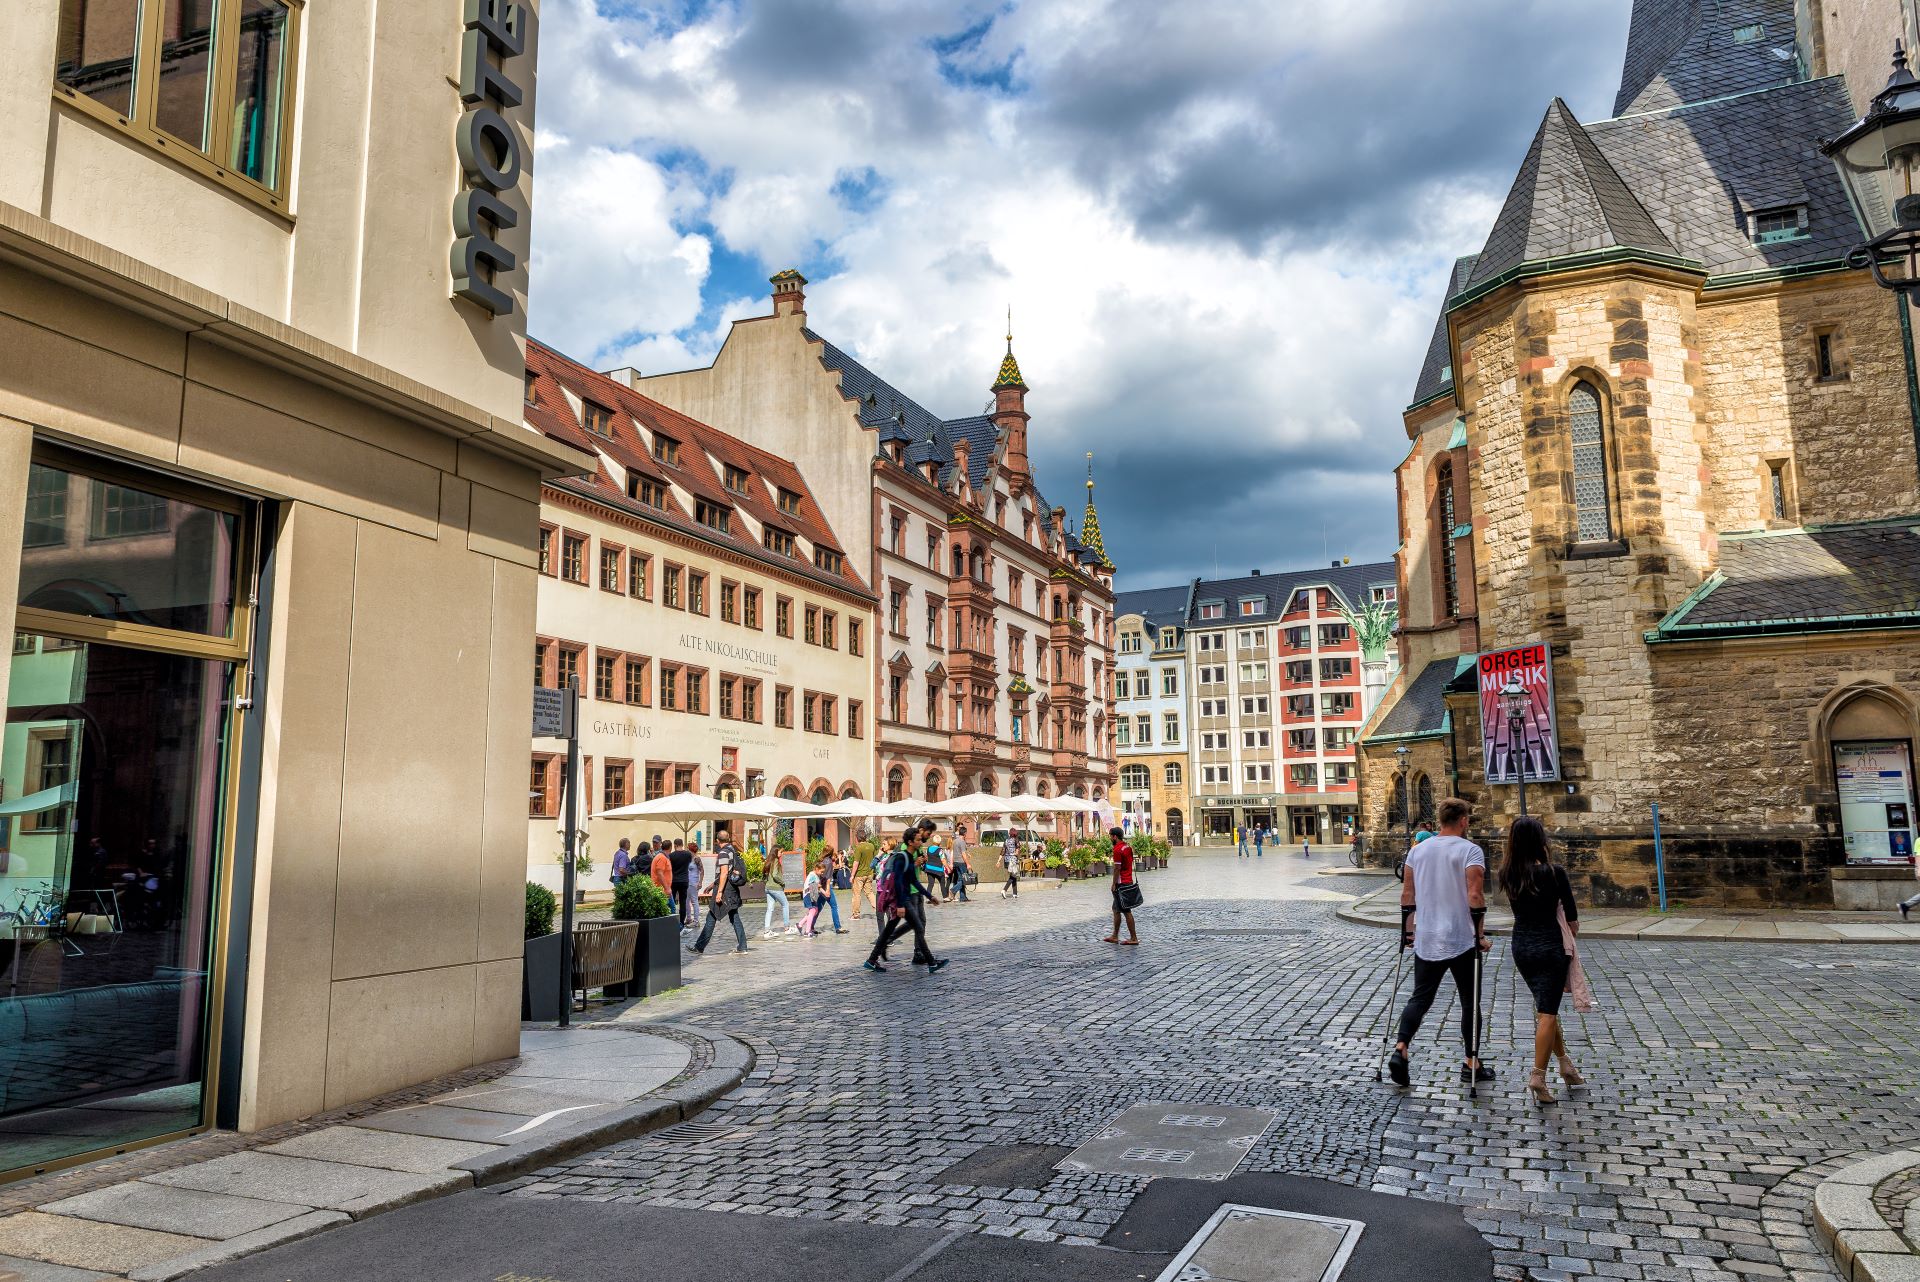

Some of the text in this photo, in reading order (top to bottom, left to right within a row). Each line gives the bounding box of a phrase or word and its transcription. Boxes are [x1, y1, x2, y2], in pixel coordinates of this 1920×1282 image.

[679, 633, 778, 667] ALTE NIKOLAISCHULE
[1481, 648, 1545, 673] ORGEL
[1482, 665, 1547, 692] MUSIK
[593, 720, 651, 739] GASTHAUS
